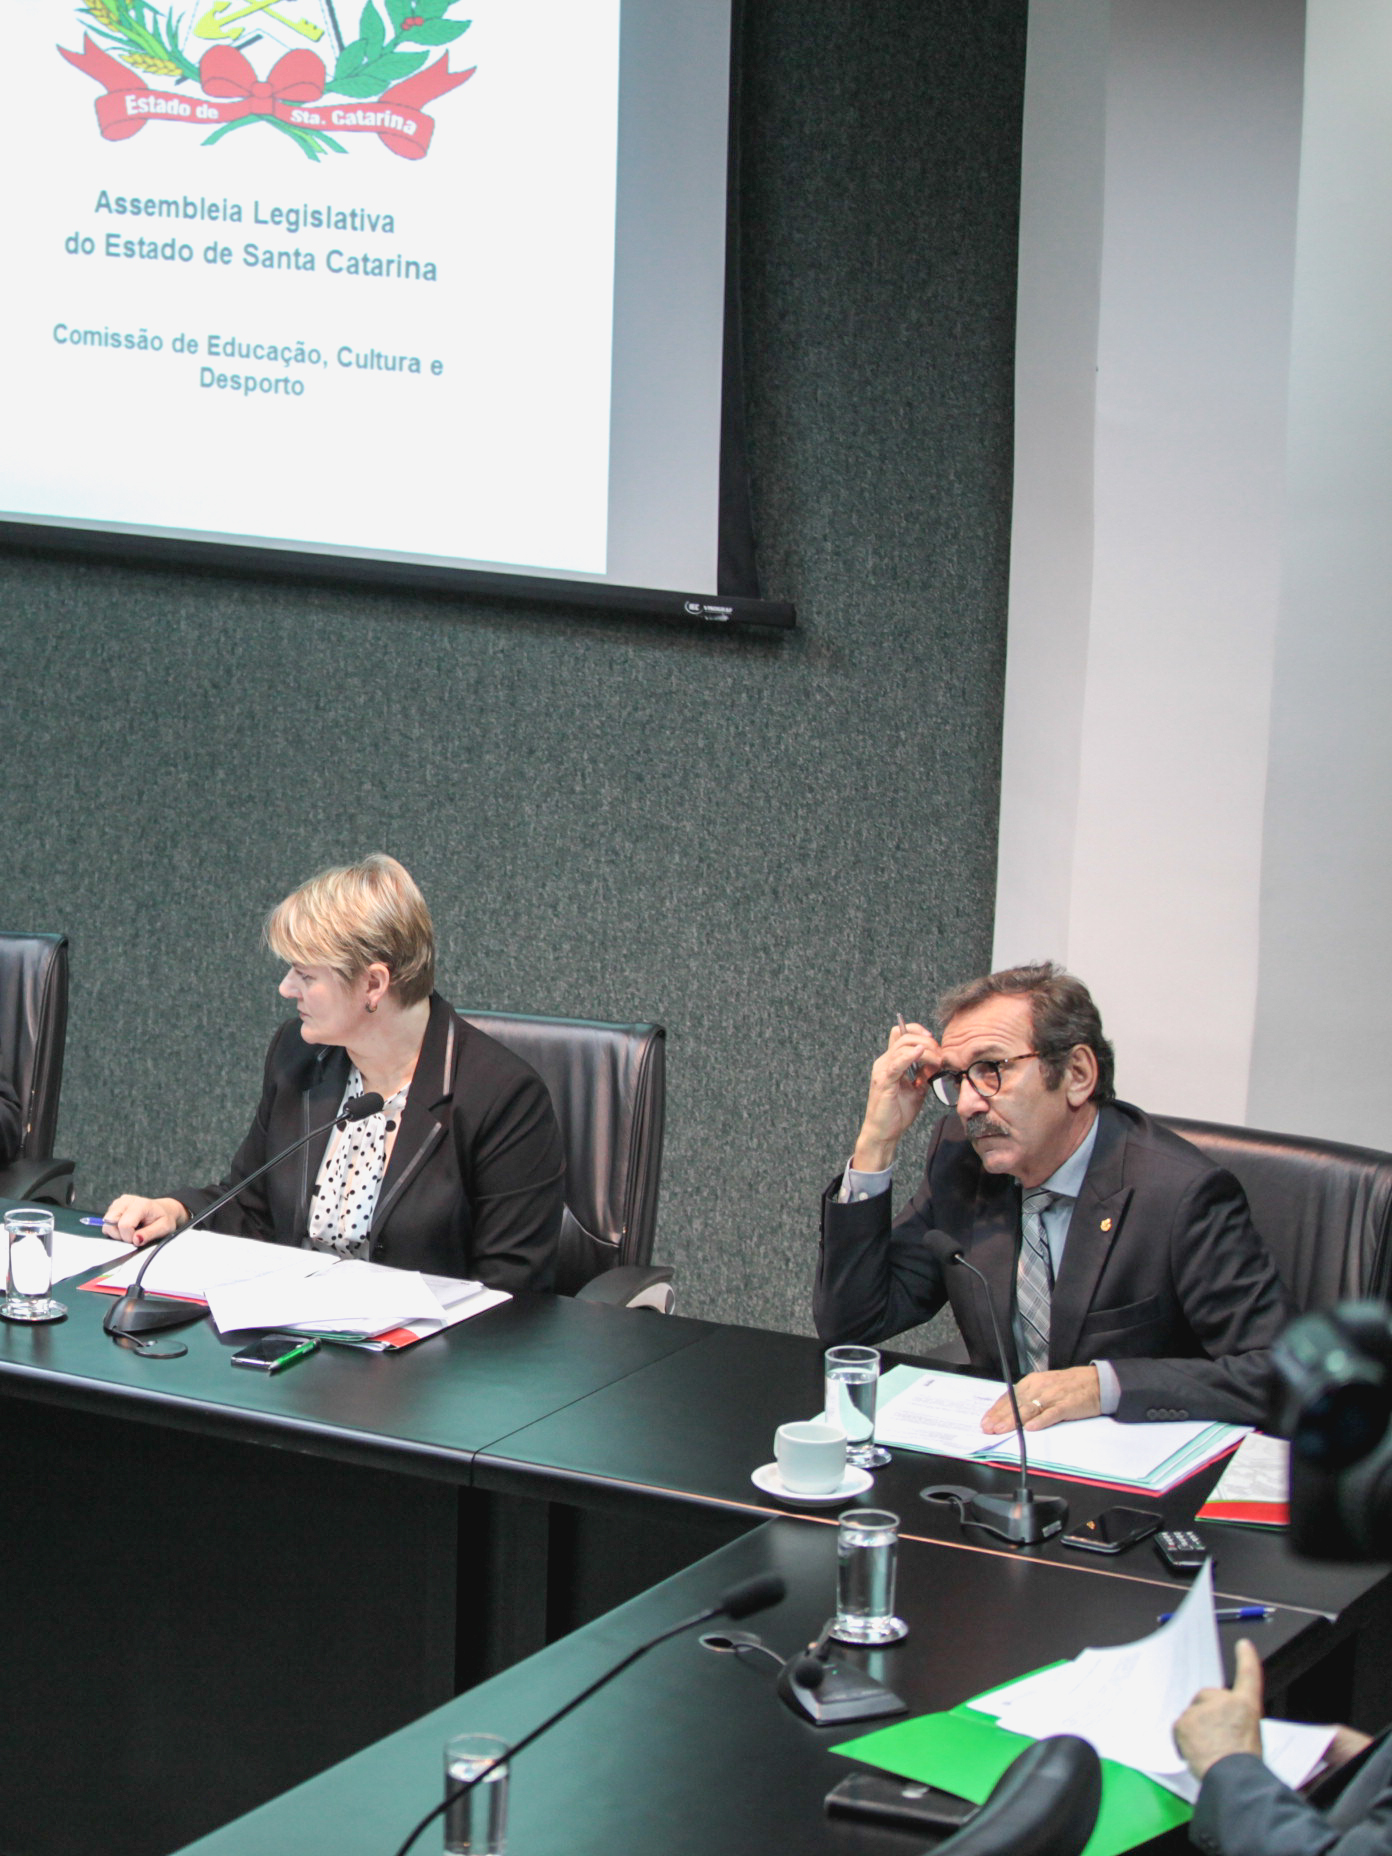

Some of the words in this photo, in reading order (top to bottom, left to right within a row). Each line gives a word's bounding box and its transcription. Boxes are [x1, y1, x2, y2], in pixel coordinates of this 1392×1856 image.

[125, 94, 191, 117] Estado
[195, 101, 219, 120] de
[290, 108, 327, 126] Sta.
[331, 110, 418, 136] Catarina
[94, 190, 242, 223] Assembleia
[254, 200, 394, 234] Legislativa
[64, 231, 96, 255] do
[105, 232, 194, 262] Estado
[203, 240, 233, 265] de
[242, 243, 315, 271] Santa
[326, 249, 437, 282] Catarina
[53, 323, 164, 351] Comissão
[172, 332, 199, 355] de
[207, 335, 328, 368] Educação,
[337, 346, 421, 374] Cultura
[430, 360, 444, 376] e
[200, 366, 305, 397] Desporto
